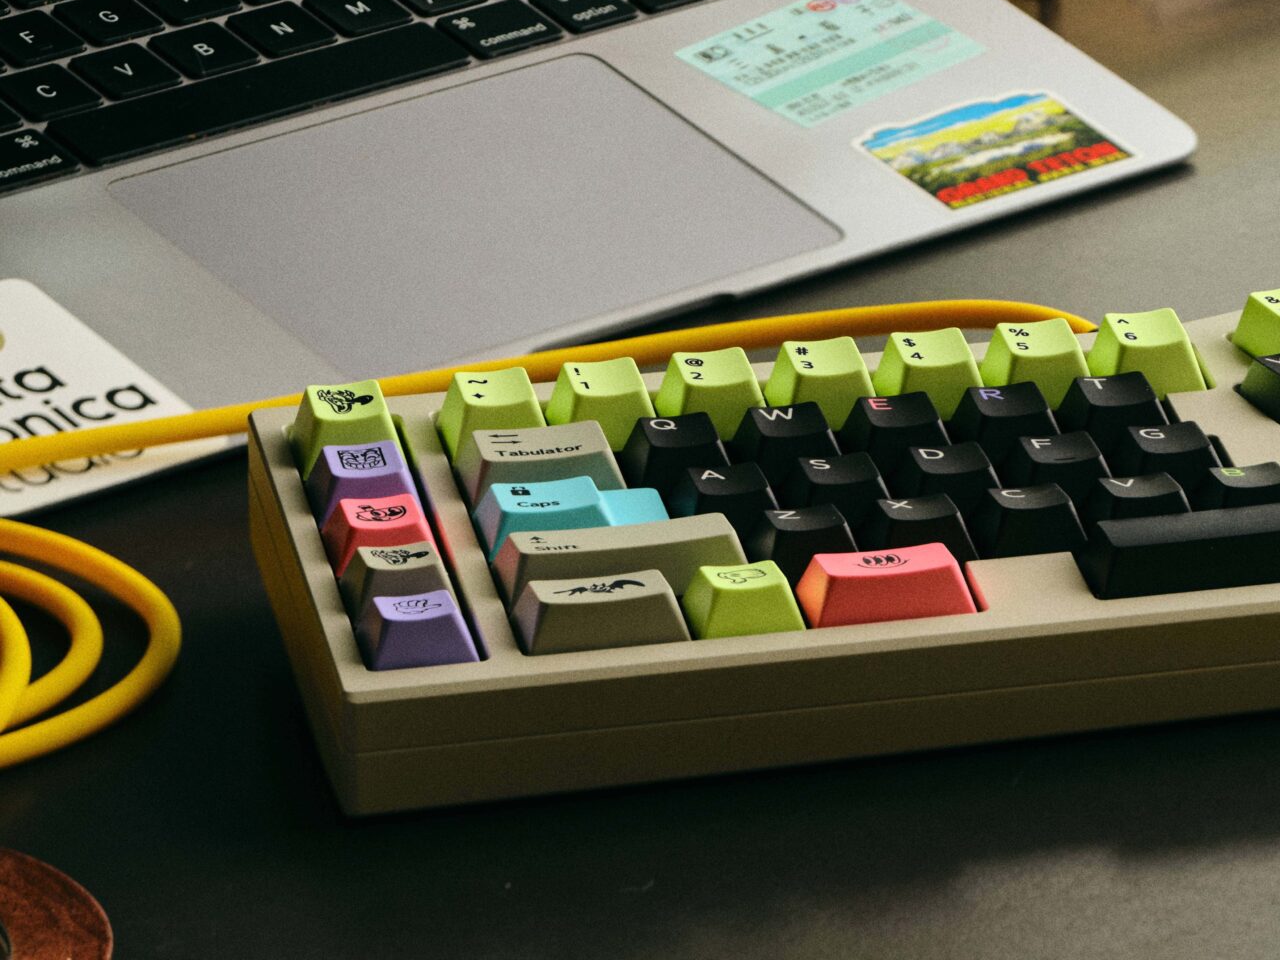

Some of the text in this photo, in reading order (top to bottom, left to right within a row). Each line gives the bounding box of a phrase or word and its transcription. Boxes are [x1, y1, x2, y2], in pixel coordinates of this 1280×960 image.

[345, 1, 371, 15] M
[572, 3, 617, 22] option
[99, 11, 119, 23] G
[270, 21, 294, 35] N
[19, 31, 35, 44] F
[480, 23, 547, 47] command
[193, 43, 214, 56] B
[113, 63, 133, 76] V
[36, 85, 57, 97] C
[1124, 332, 1137, 341] 6
[911, 352, 924, 360] 4
[801, 361, 814, 369] 3
[691, 372, 703, 380] 2
[580, 381, 590, 390] 1
[1084, 379, 1106, 389] T
[979, 389, 1004, 400] R
[868, 398, 892, 410] E
[759, 408, 793, 421] W
[650, 419, 677, 430] Q
[1140, 429, 1165, 439] G
[1031, 439, 1051, 448] F
[495, 444, 582, 457] Tabulator
[918, 449, 945, 460] D
[809, 459, 831, 470] S
[700, 470, 725, 481] A
[1221, 469, 1245, 477] B
[1110, 479, 1134, 487] V
[1001, 490, 1025, 498] C
[517, 499, 560, 509] Caps
[887, 500, 913, 509] X
[774, 510, 800, 520] Z
